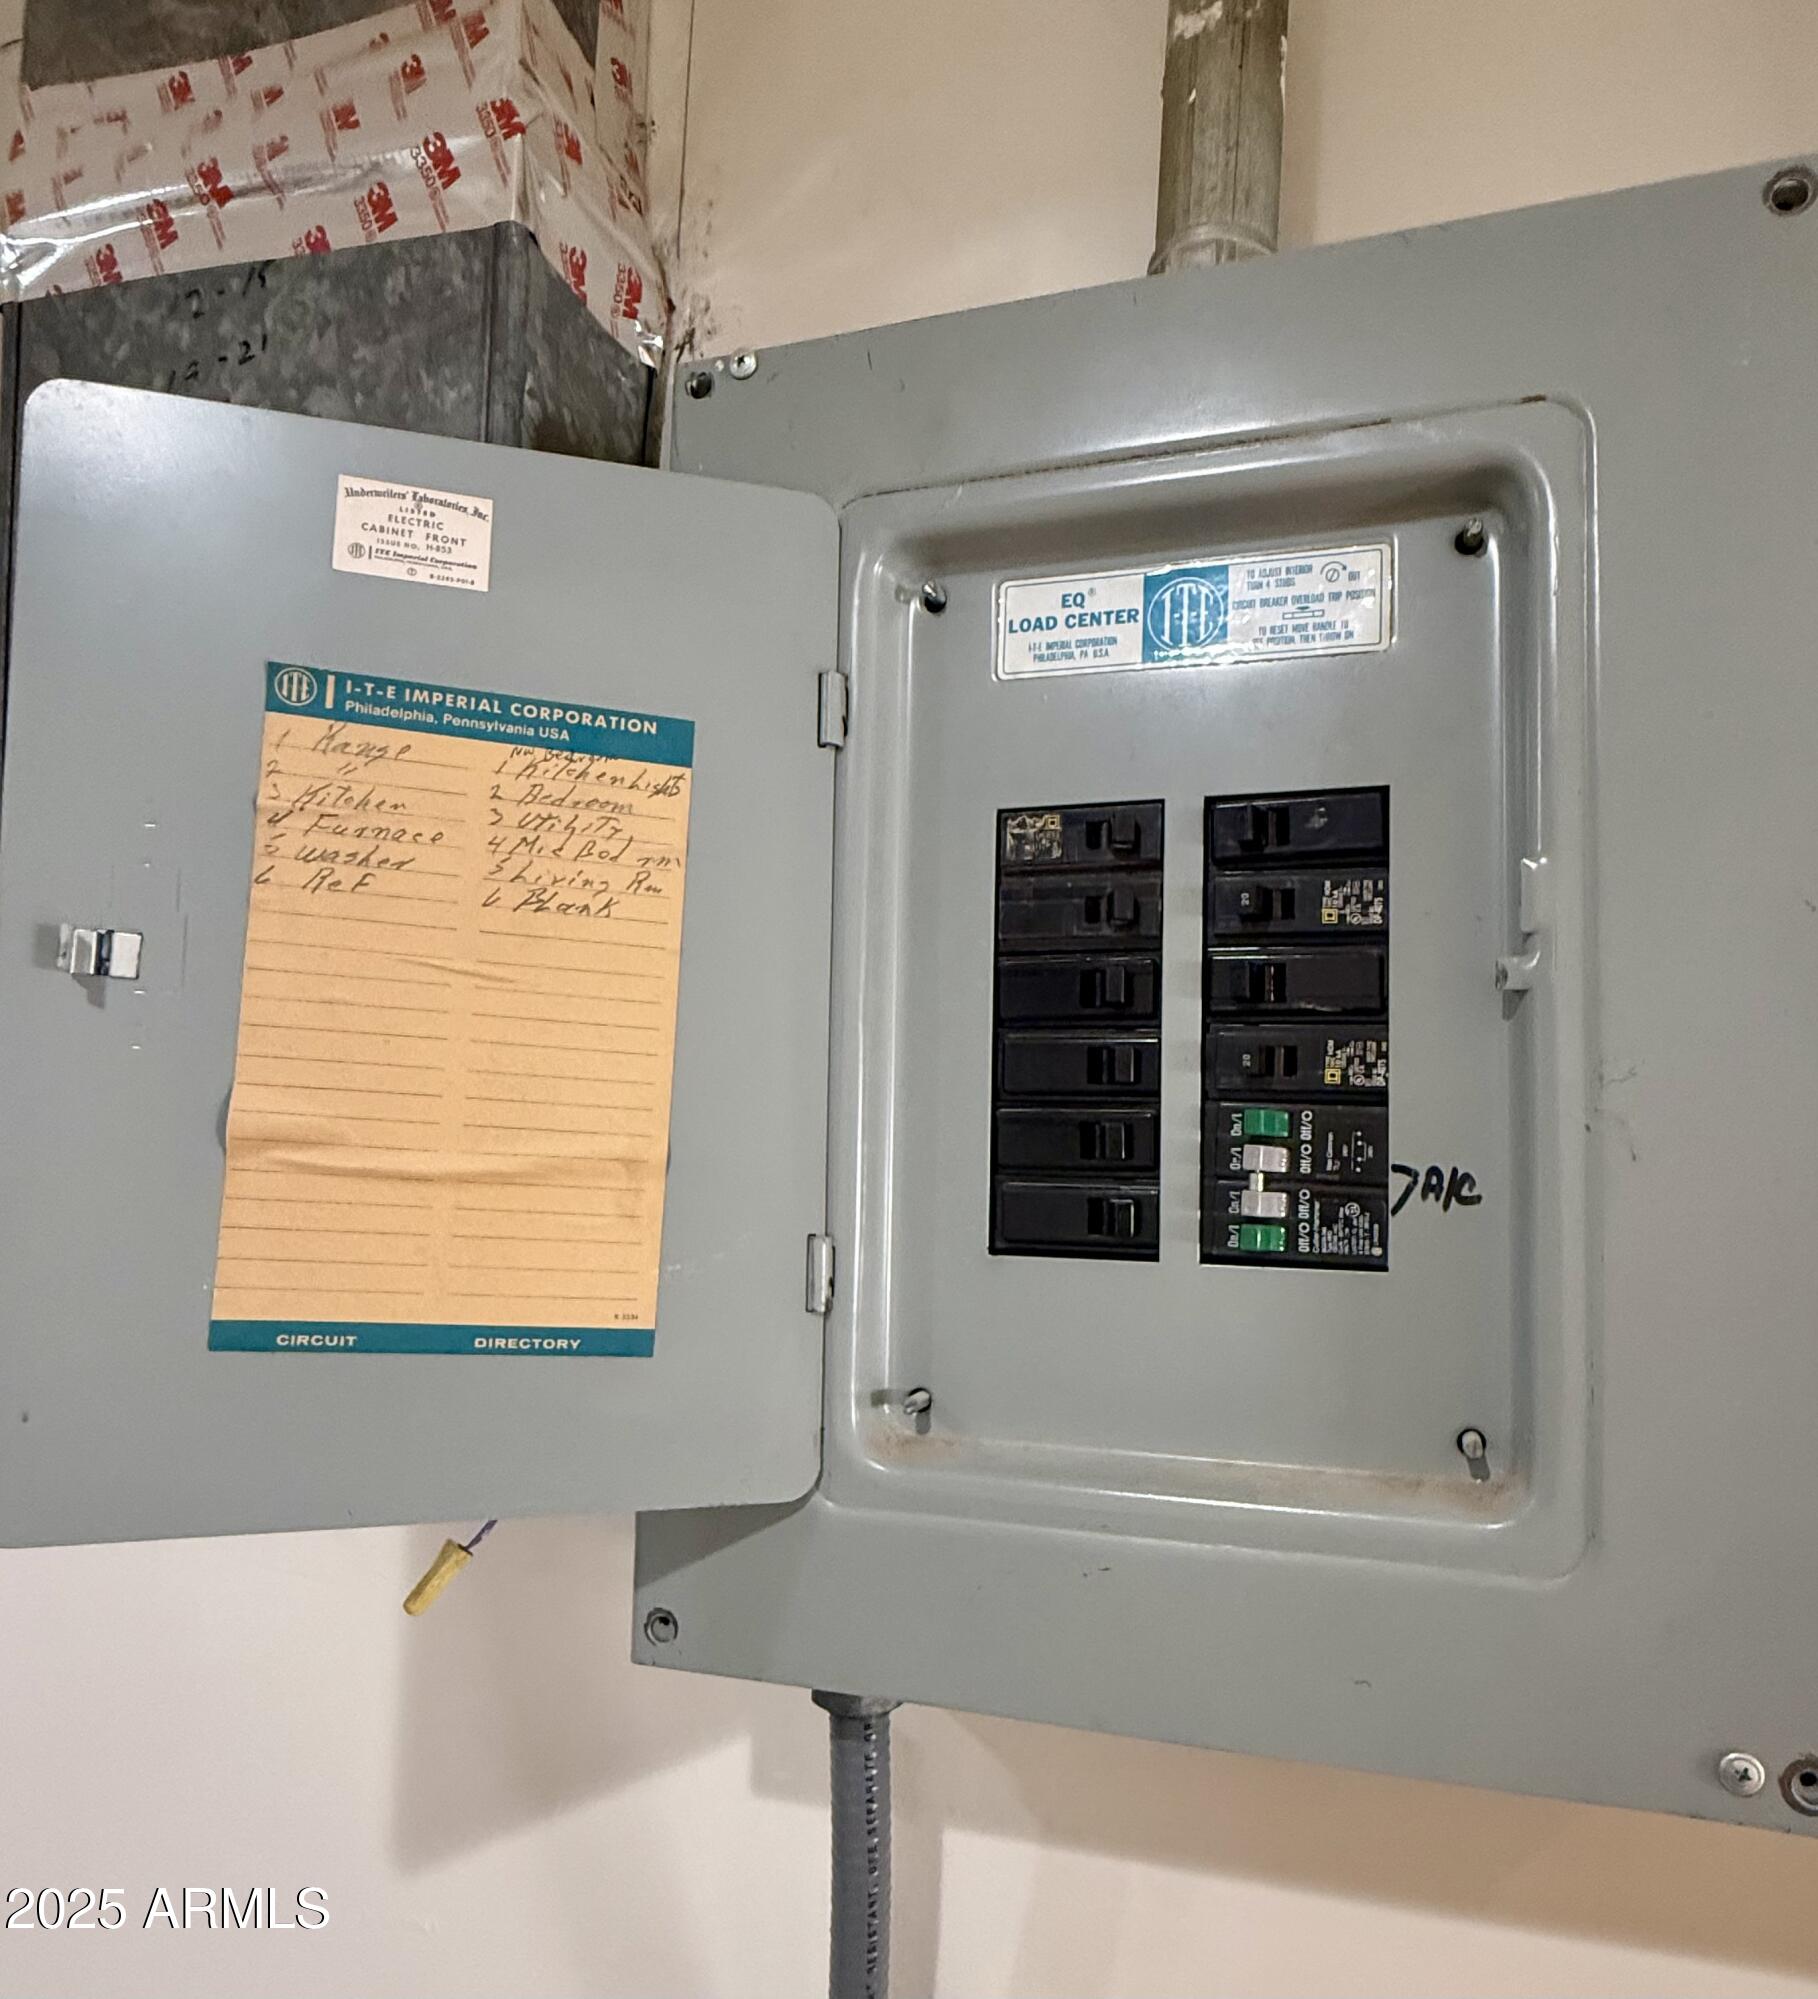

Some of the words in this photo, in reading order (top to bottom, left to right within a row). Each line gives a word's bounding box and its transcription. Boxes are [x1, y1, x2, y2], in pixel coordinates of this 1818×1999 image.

[410, 144, 437, 188] 3350
[423, 132, 461, 190] 3M
[367, 181, 398, 233] 3M
[361, 522, 414, 539] CABINET
[425, 533, 467, 547] FRONT
[388, 514, 444, 531] ELECTRIC
[1259, 596, 1288, 608] BREAKER
[1291, 592, 1325, 606] OVERLOAD
[1328, 591, 1342, 602] TRIP
[1008, 615, 1058, 634] LOAD
[1065, 607, 1140, 629] CENTER
[1270, 624, 1289, 635] RESET
[1045, 640, 1072, 651] IMPERIAL
[1075, 636, 1118, 648] CORPORATION
[346, 679, 397, 700] I-T-E
[405, 687, 502, 715] IMPERIAL
[510, 703, 658, 735] CORPORATION
[345, 700, 438, 725] Philadelphia,
[443, 713, 535, 737] Pennsylvania
[539, 727, 570, 742] USA
[303, 814, 444, 844] Furnace
[488, 836, 507, 855] 4
[1241, 893, 1250, 906] 20
[1242, 1054, 1251, 1067] 20
[1420, 1165, 1482, 1213] A/C
[276, 1334, 357, 1349] CIRCUIT
[474, 1337, 582, 1351] DIRECTORY
